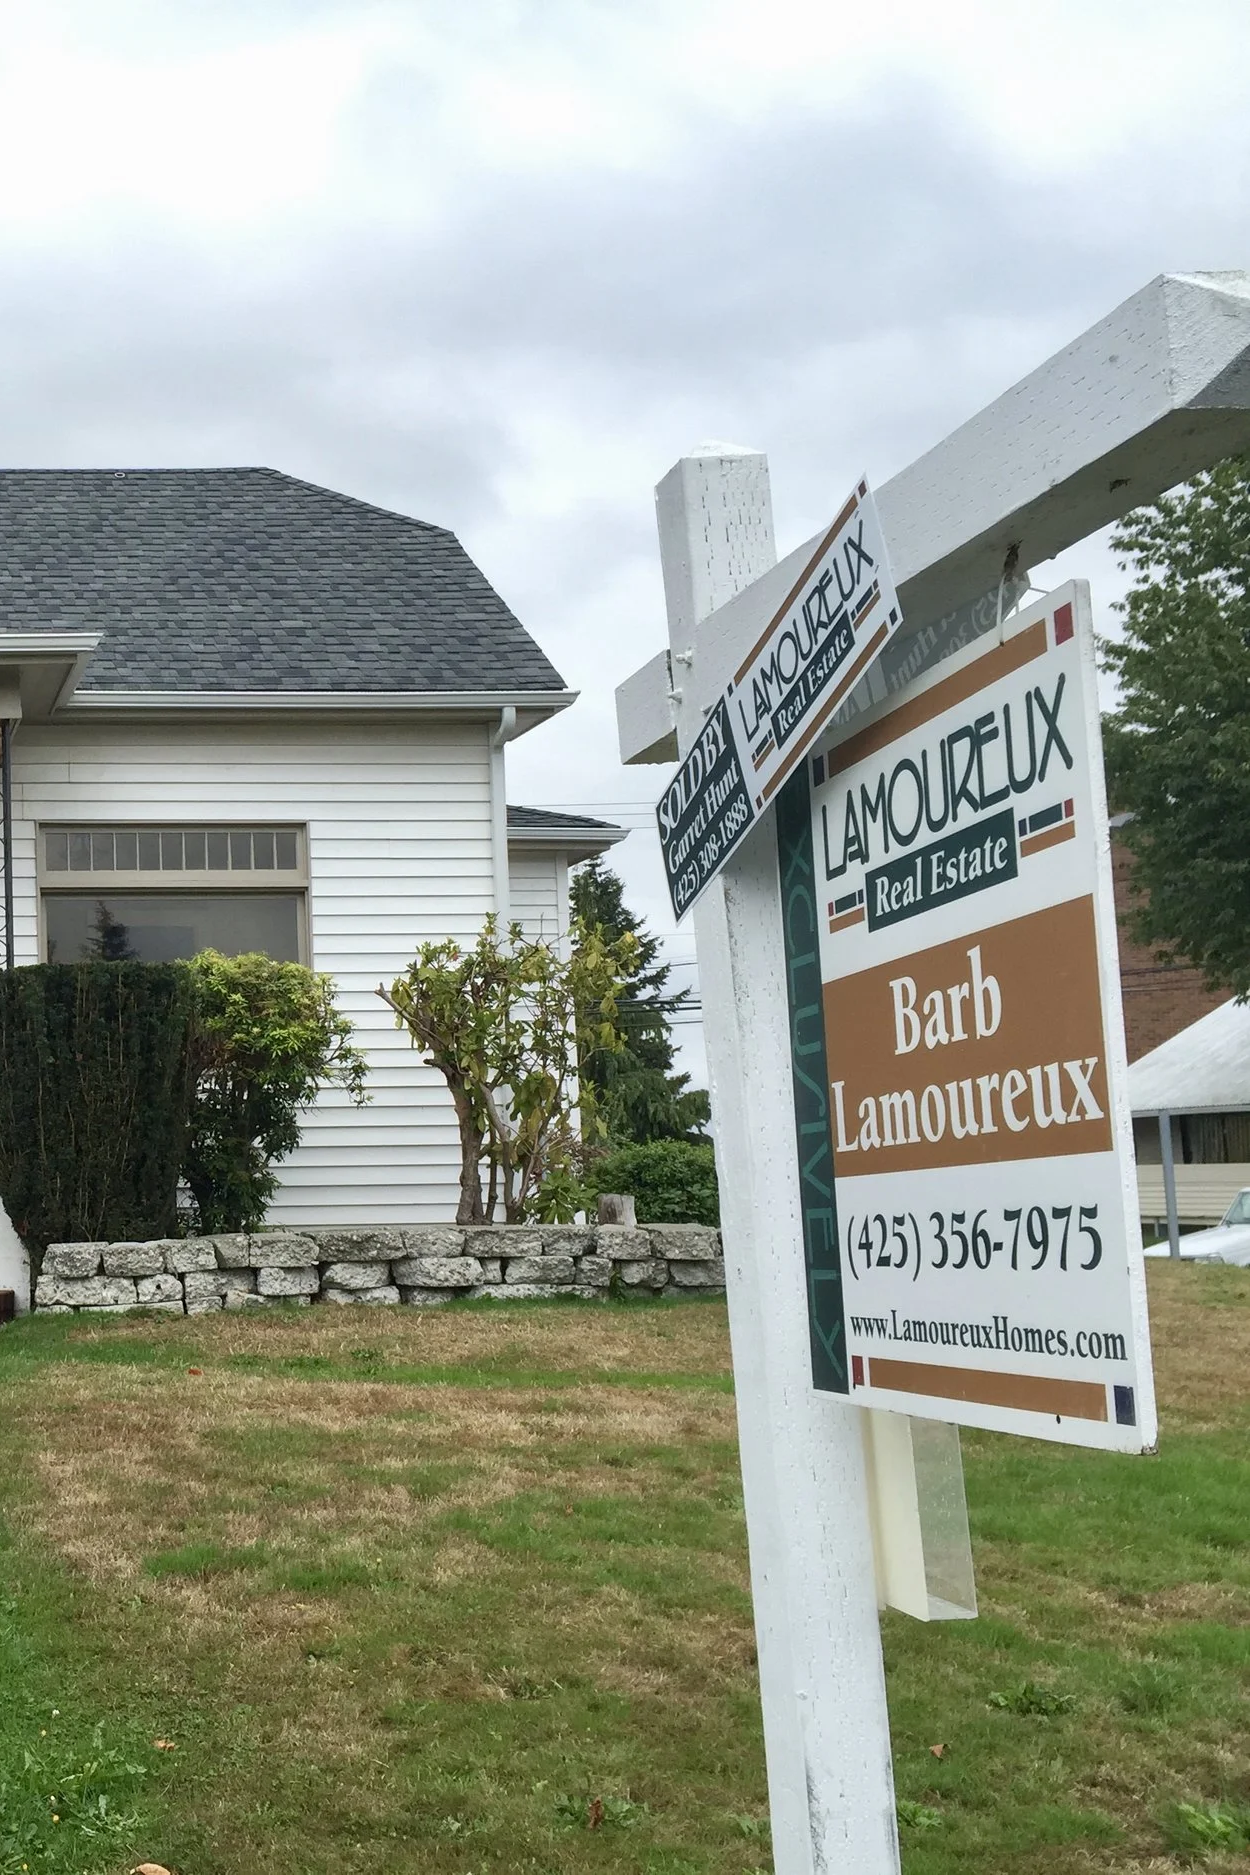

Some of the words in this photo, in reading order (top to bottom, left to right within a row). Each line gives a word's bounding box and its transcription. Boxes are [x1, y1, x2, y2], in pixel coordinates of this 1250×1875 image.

[738, 519, 874, 744] LAMOUREUX
[777, 696, 807, 738] Real
[809, 628, 850, 691] Estate
[659, 747, 703, 845] SOLD
[703, 703, 727, 777] BY
[668, 803, 707, 875] Garret
[703, 757, 740, 824] Hunt
[821, 672, 1073, 881] LAMOUREUX
[673, 859, 701, 914] (425)
[698, 792, 749, 878] 308-1888
[875, 855, 923, 917] Real
[930, 835, 1009, 896] Estate
[889, 944, 1002, 1055] Barb
[781, 800, 844, 1380] XCLUSIVELY
[831, 1056, 1104, 1152] Lamoureux
[847, 1211, 921, 1282] (425)
[929, 1204, 1103, 1271] 356-7975
[849, 1309, 1128, 1361] www.LamoureuxHomes.com
